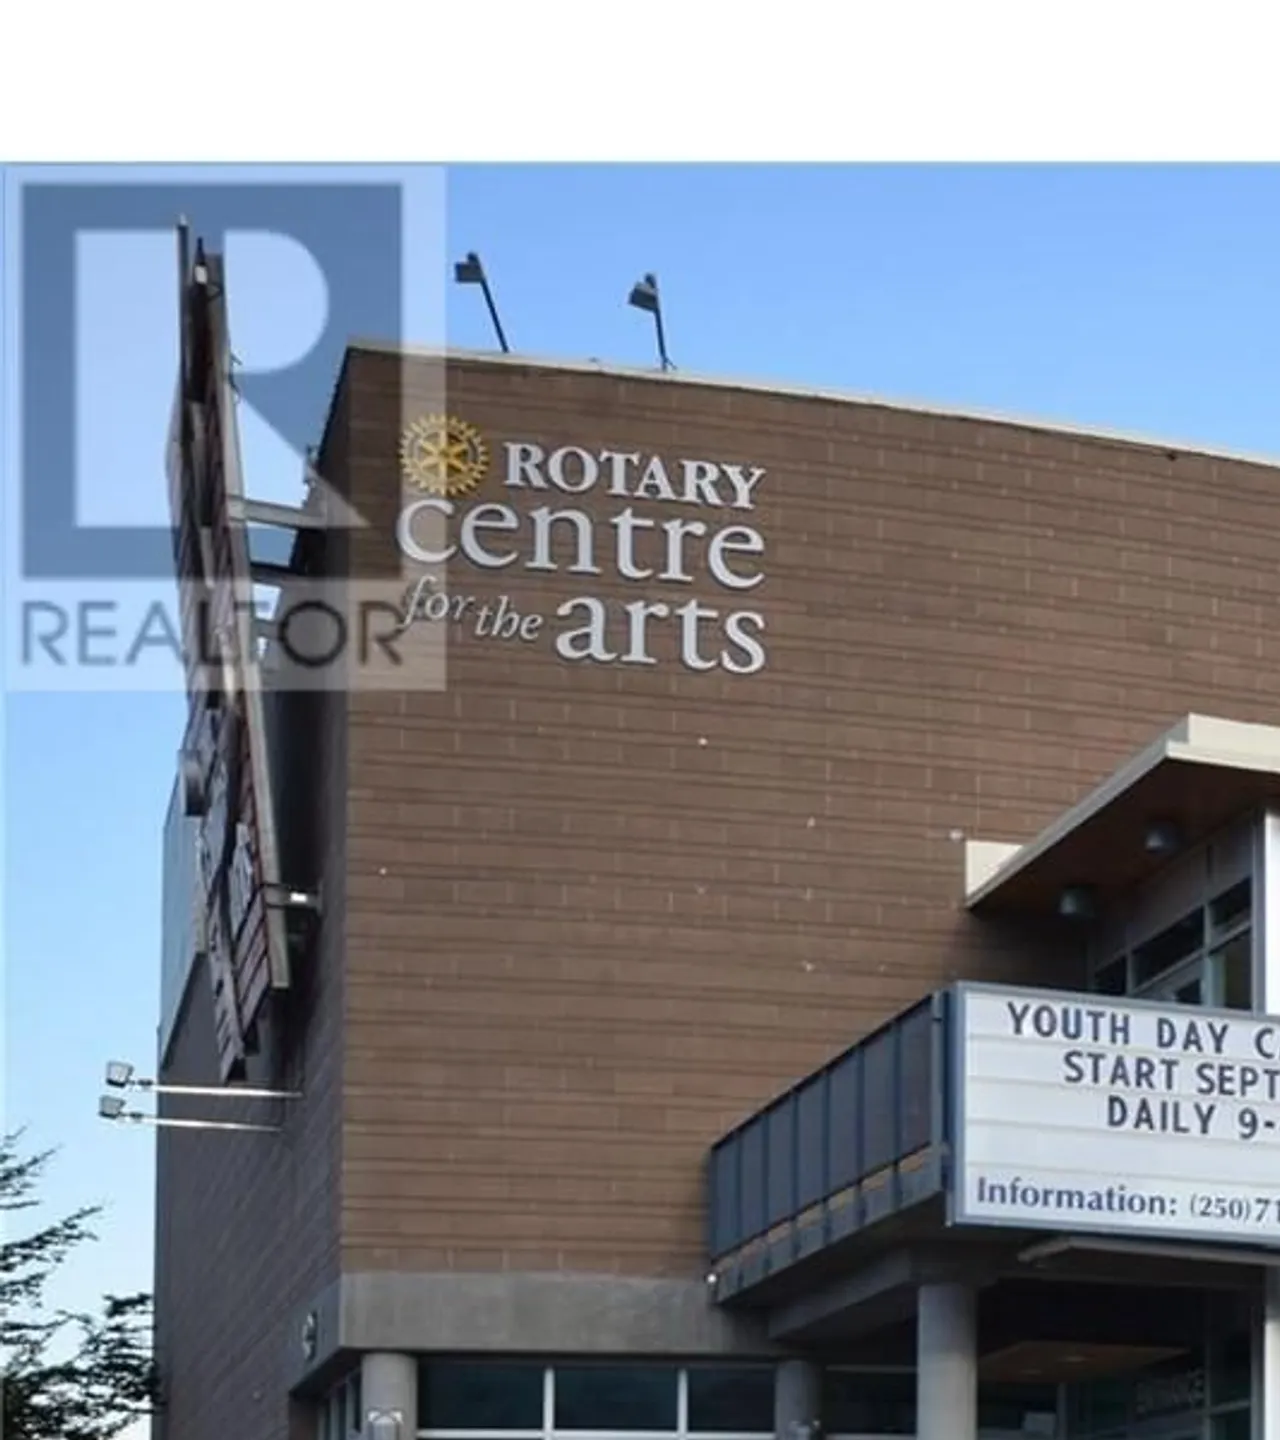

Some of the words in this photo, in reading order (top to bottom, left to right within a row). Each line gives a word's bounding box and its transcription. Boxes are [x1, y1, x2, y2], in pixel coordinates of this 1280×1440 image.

[503, 442, 767, 510] ROTARY
[396, 498, 765, 589] centre
[404, 575, 475, 626] for
[475, 596, 544, 641] the
[555, 597, 766, 674] arts
[1007, 1002, 1131, 1046] YOUTH
[1157, 1017, 1230, 1054] DAY
[1064, 1050, 1179, 1092] START
[1107, 1096, 1216, 1135] DAILY
[977, 1176, 1178, 1217] Information:
